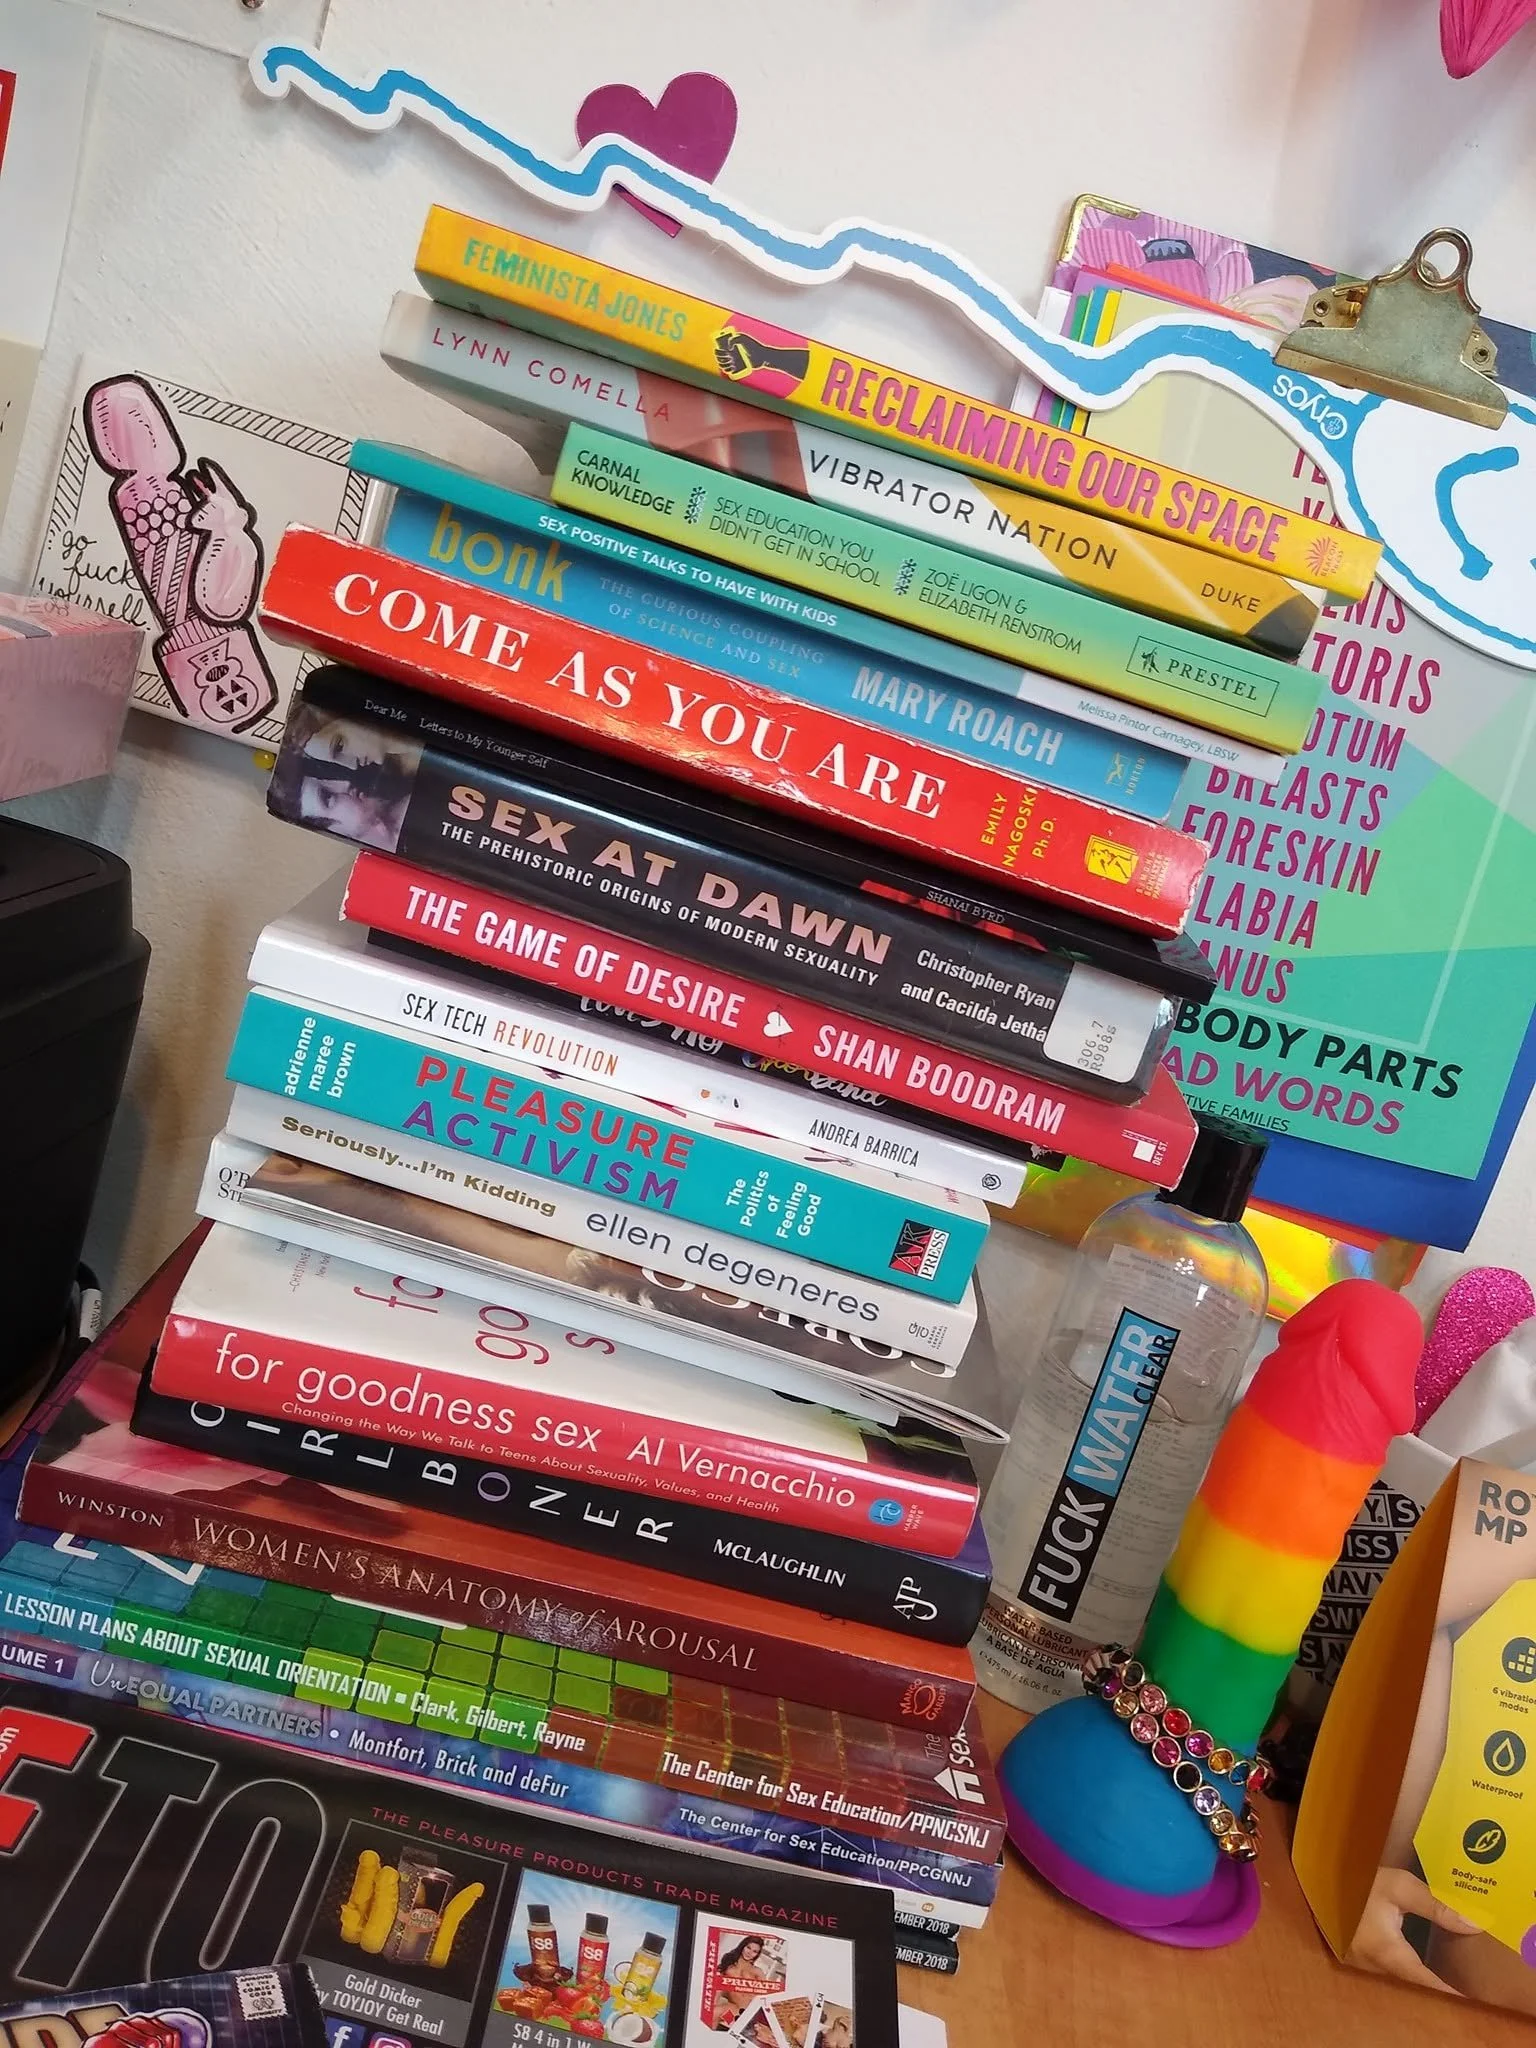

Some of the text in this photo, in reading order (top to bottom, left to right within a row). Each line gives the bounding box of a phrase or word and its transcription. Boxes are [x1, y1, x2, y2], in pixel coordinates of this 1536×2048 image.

[462, 238, 687, 341] FEMINISTA JONES
[431, 327, 671, 423] LYNN COMELLA
[571, 467, 675, 517] KNOWLEDGE
[577, 449, 641, 484] CARNAL
[821, 360, 1074, 491] RECLAIMING
[1077, 451, 1160, 519] OUR
[1163, 482, 1290, 563] SPACE
[714, 496, 874, 562] SEX EDUCATION YOU
[809, 450, 1118, 571] VIBRATOR NATION
[62, 530, 97, 560] go
[63, 551, 143, 597] fuck
[429, 503, 573, 602] bonk
[538, 515, 837, 627] SEX POSITIVE TALKS TO HAVE WITH KIDS
[708, 515, 881, 588] DIDN'T GET SCHOOL
[918, 586, 1082, 655] ELIZABETH RENSTROM
[960, 578, 1013, 610] LIGON
[1201, 582, 1262, 613] DUKE
[638, 610, 714, 651] SCIENCE
[334, 571, 947, 820] COME AS YOU ARE
[1165, 658, 1259, 701] PRESTEL
[364, 699, 551, 769] Dear Letters Younger Self
[851, 667, 1063, 766] MARY ROACH
[1077, 700, 1151, 733] Melissa Pintor
[981, 793, 1008, 846] EMILY
[1001, 786, 1038, 867] NAGOSKI
[440, 821, 881, 987] THE PREHISTORIC ORIGINS OF MODERN SEXUALITY
[447, 785, 892, 965] SEX AT DAWN
[1195, 875, 1320, 950] LABIA
[405, 884, 465, 934] THE
[474, 910, 567, 970] GAME
[573, 943, 619, 984] OF
[624, 958, 746, 1029] DESIRE
[812, 1022, 900, 1078] SHAN
[904, 1055, 1068, 1136] BOODRAM
[900, 979, 1048, 1044] and Cacilda Jethá
[916, 948, 1056, 1012] Christopher Ryan
[283, 1016, 317, 1096] adrienne
[308, 1034, 336, 1092] maree
[401, 993, 439, 1023] SEX
[442, 1005, 487, 1037] TECH
[493, 1020, 619, 1077] REVOLUTION
[1077, 1019, 1105, 1069] 306.7
[1176, 1002, 1465, 1099] BODY PARTS
[329, 1041, 357, 1099] brown
[1234, 1061, 1406, 1135] WORDS
[415, 1055, 696, 1170] PLEASURE
[808, 1119, 921, 1169] ANDREA BARRICA
[1220, 1102, 1291, 1133] FAMILIES
[401, 1101, 681, 1210] ACTIVISM
[726, 1178, 747, 1206] The
[740, 1170, 769, 1227] Politics
[777, 1181, 807, 1239] Feeling
[797, 1195, 822, 1237] Good
[463, 1174, 880, 1323] Kidding ellen degeneres
[921, 1230, 950, 1278] PRESS
[1132, 1333, 1175, 1406] CLEAR
[214, 1332, 856, 1510] for goodness sex Al Vernacchio
[281, 1402, 780, 1514] Changing Teens About Health
[904, 1504, 917, 1532] HARPER
[1029, 1486, 1105, 1610] FUCK
[57, 1490, 165, 1528] WINSTON
[193, 1515, 368, 1584] WOMEN'S
[380, 1562, 563, 1624] ANATOMY
[602, 1614, 758, 1674] AROUSAL
[713, 1538, 848, 1588] MCLAUGHLIN
[994, 1640, 1019, 1661] BASE
[1004, 1604, 1072, 1645] WATER-BASED
[1032, 1634, 1089, 1658] LUBRICANT
[4, 1592, 818, 1808] LESSON PLANS ABOUT SEXUAL ORIENTATION Clark, Gilbert, Rayne The Center for Sex
[900, 1677, 922, 1715] MANGO
[209, 1696, 817, 1853] PARTNERS Montfort, Brick and deFur The Center for Sex
[1472, 1778, 1524, 1801] Waterproof
[372, 1806, 840, 1930] THE PLEASURE PRODUCTS TRADE MAGAZINE
[1451, 1866, 1498, 1888] Body-safe
[242, 1984, 277, 1993] COMICS
[249, 1989, 272, 1998] CODE
[332, 1990, 446, 2037] TOYJOY Get Real
[344, 1974, 422, 2009] Gold Dicker
[721, 1976, 782, 1992] PRIVATE
